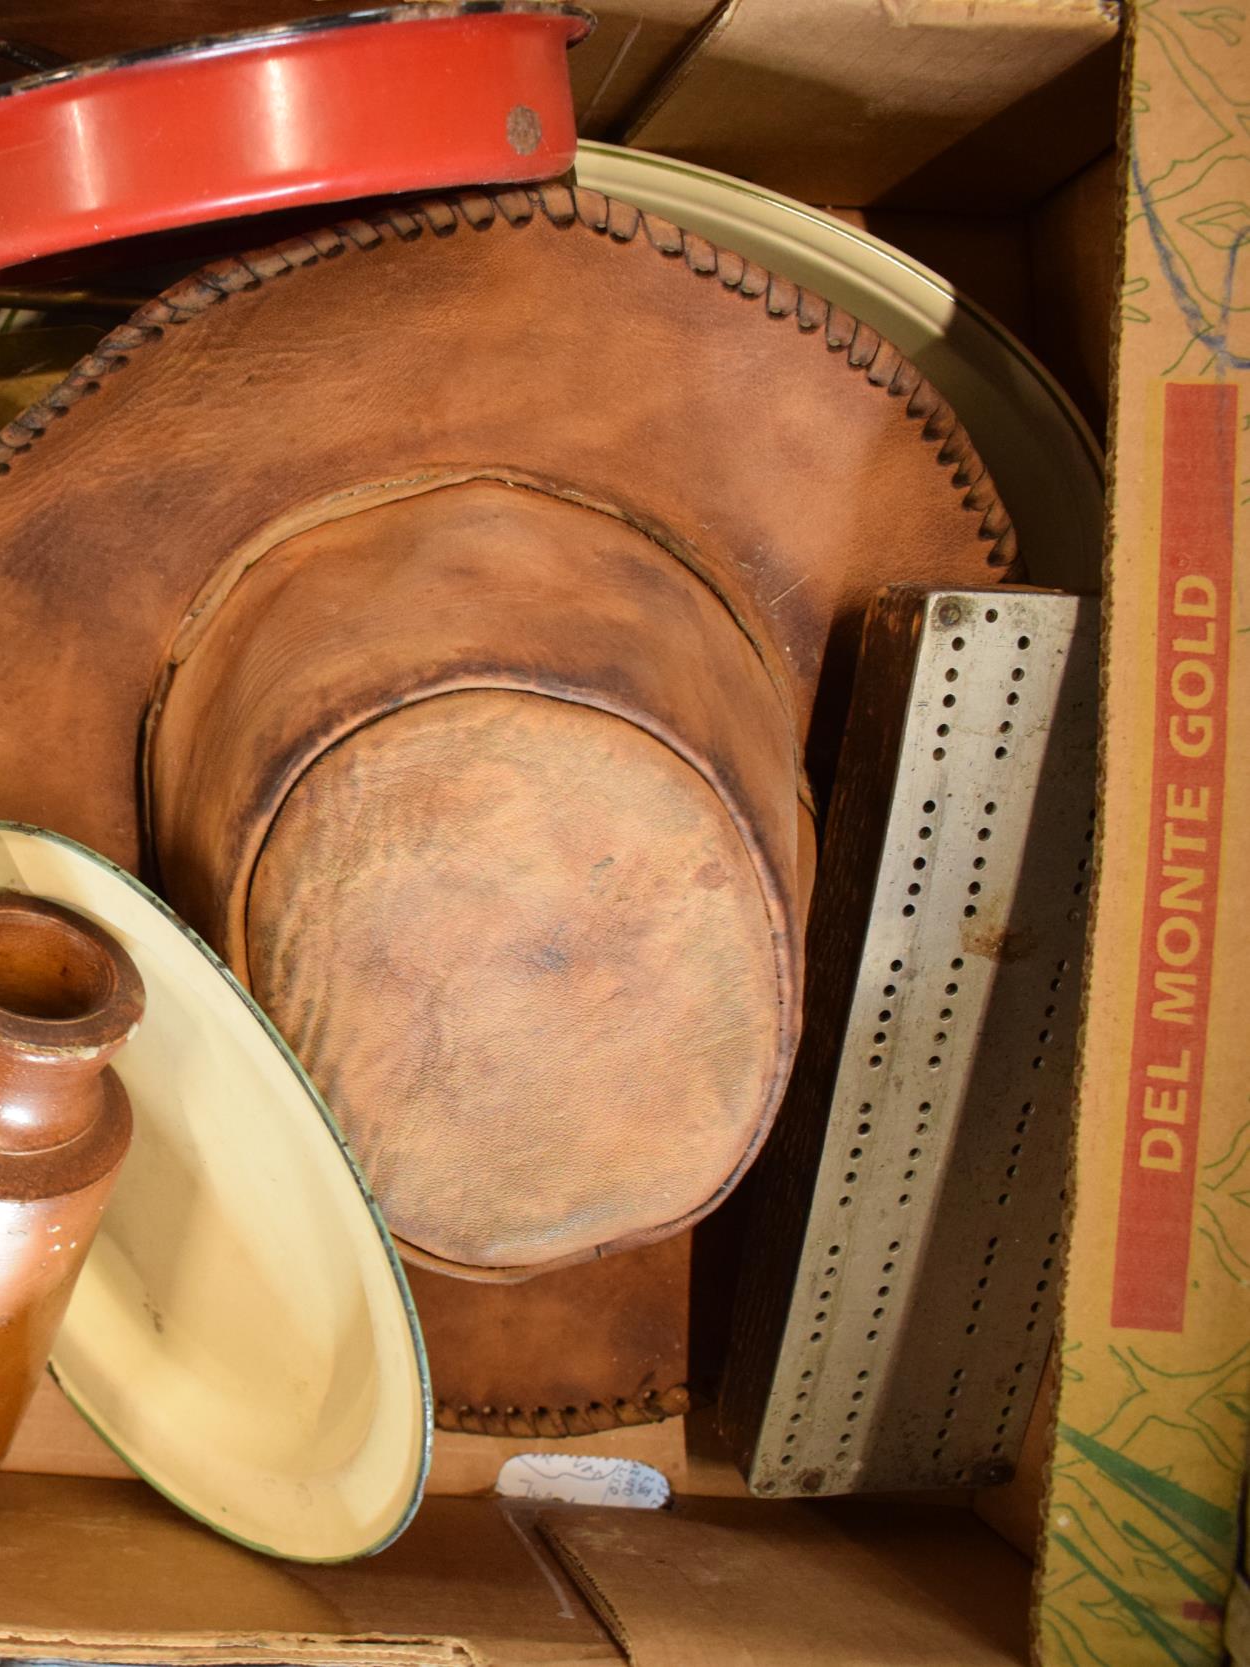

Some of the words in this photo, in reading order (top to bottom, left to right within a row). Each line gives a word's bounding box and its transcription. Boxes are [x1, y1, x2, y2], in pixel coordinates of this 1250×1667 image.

[1168, 574, 1217, 758] GOLD
[1150, 783, 1210, 1026] MONTE
[1138, 1049, 1191, 1173] DEL
